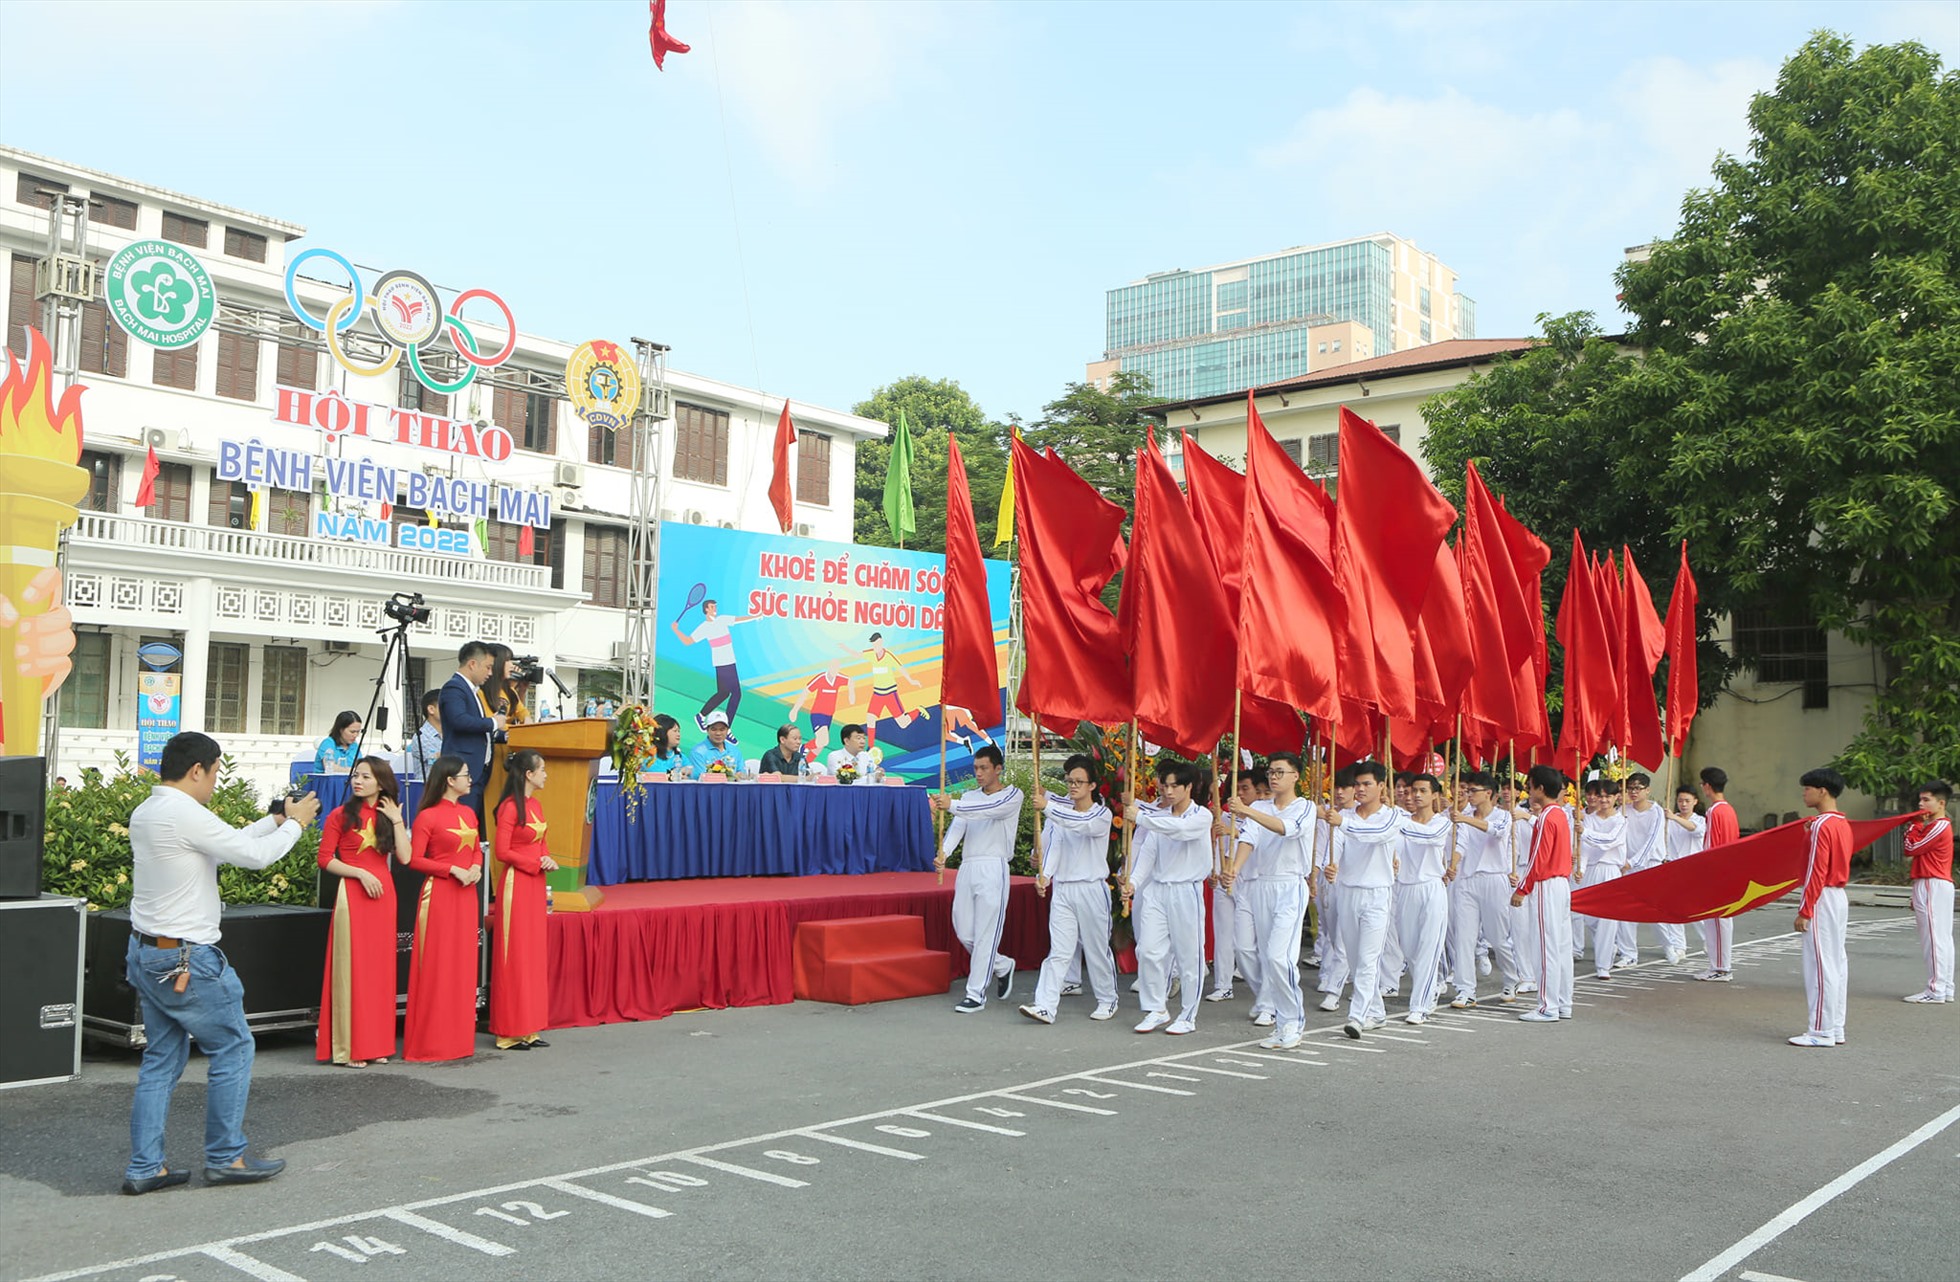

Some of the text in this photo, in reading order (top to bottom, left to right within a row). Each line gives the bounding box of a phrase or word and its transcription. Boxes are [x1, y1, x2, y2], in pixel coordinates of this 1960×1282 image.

[112, 243, 211, 299] BỆNH VIỆN BẠCH MAI
[114, 298, 207, 344] BACH MAI HOSPITAL
[275, 389, 514, 461] HỘI THAO
[220, 439, 549, 526] BỆNH VIỆN BẠCH MAI
[318, 511, 469, 553] NĂM 2022
[760, 551, 946, 594] KHOẺ ĐỂ CHĂM SÓ
[749, 587, 945, 631] SỨC KHỎE NGƯỜI DÂ
[158, 719, 176, 728] THAO
[1146, 1071, 1201, 1082] 1
[1062, 1088, 1118, 1099] 2
[973, 1106, 1027, 1118] 4
[874, 1124, 932, 1138] 6
[763, 1149, 821, 1165] 8
[624, 1170, 709, 1193] 10
[473, 1200, 572, 1226] 12
[309, 1233, 407, 1263] 14
